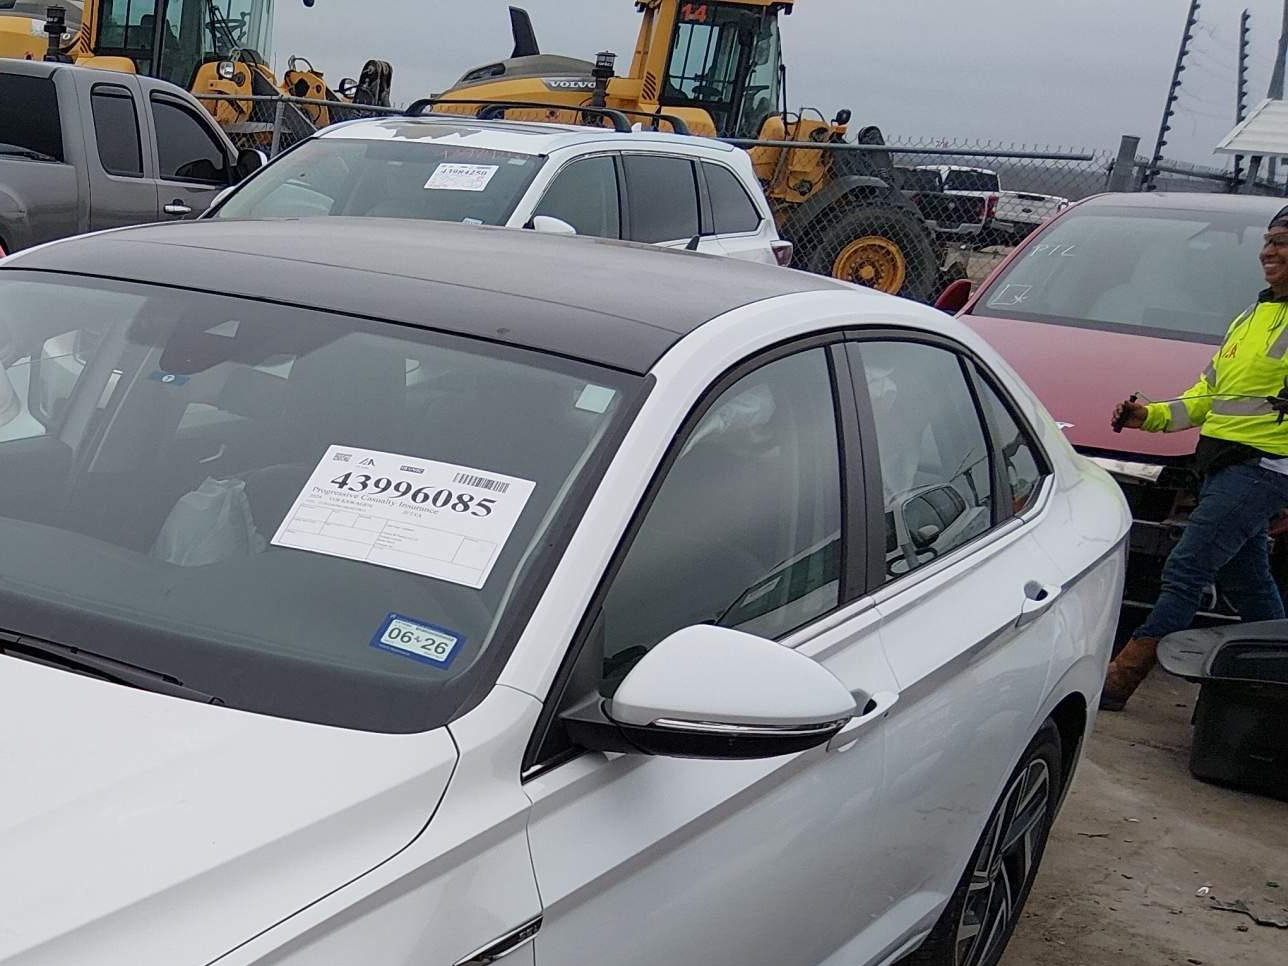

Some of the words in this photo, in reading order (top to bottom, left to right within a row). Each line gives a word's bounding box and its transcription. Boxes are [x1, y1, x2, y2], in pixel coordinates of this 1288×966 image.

[550, 81, 597, 89] VOLVO
[330, 471, 497, 518] 43996085
[398, 501, 440, 514] Insurance
